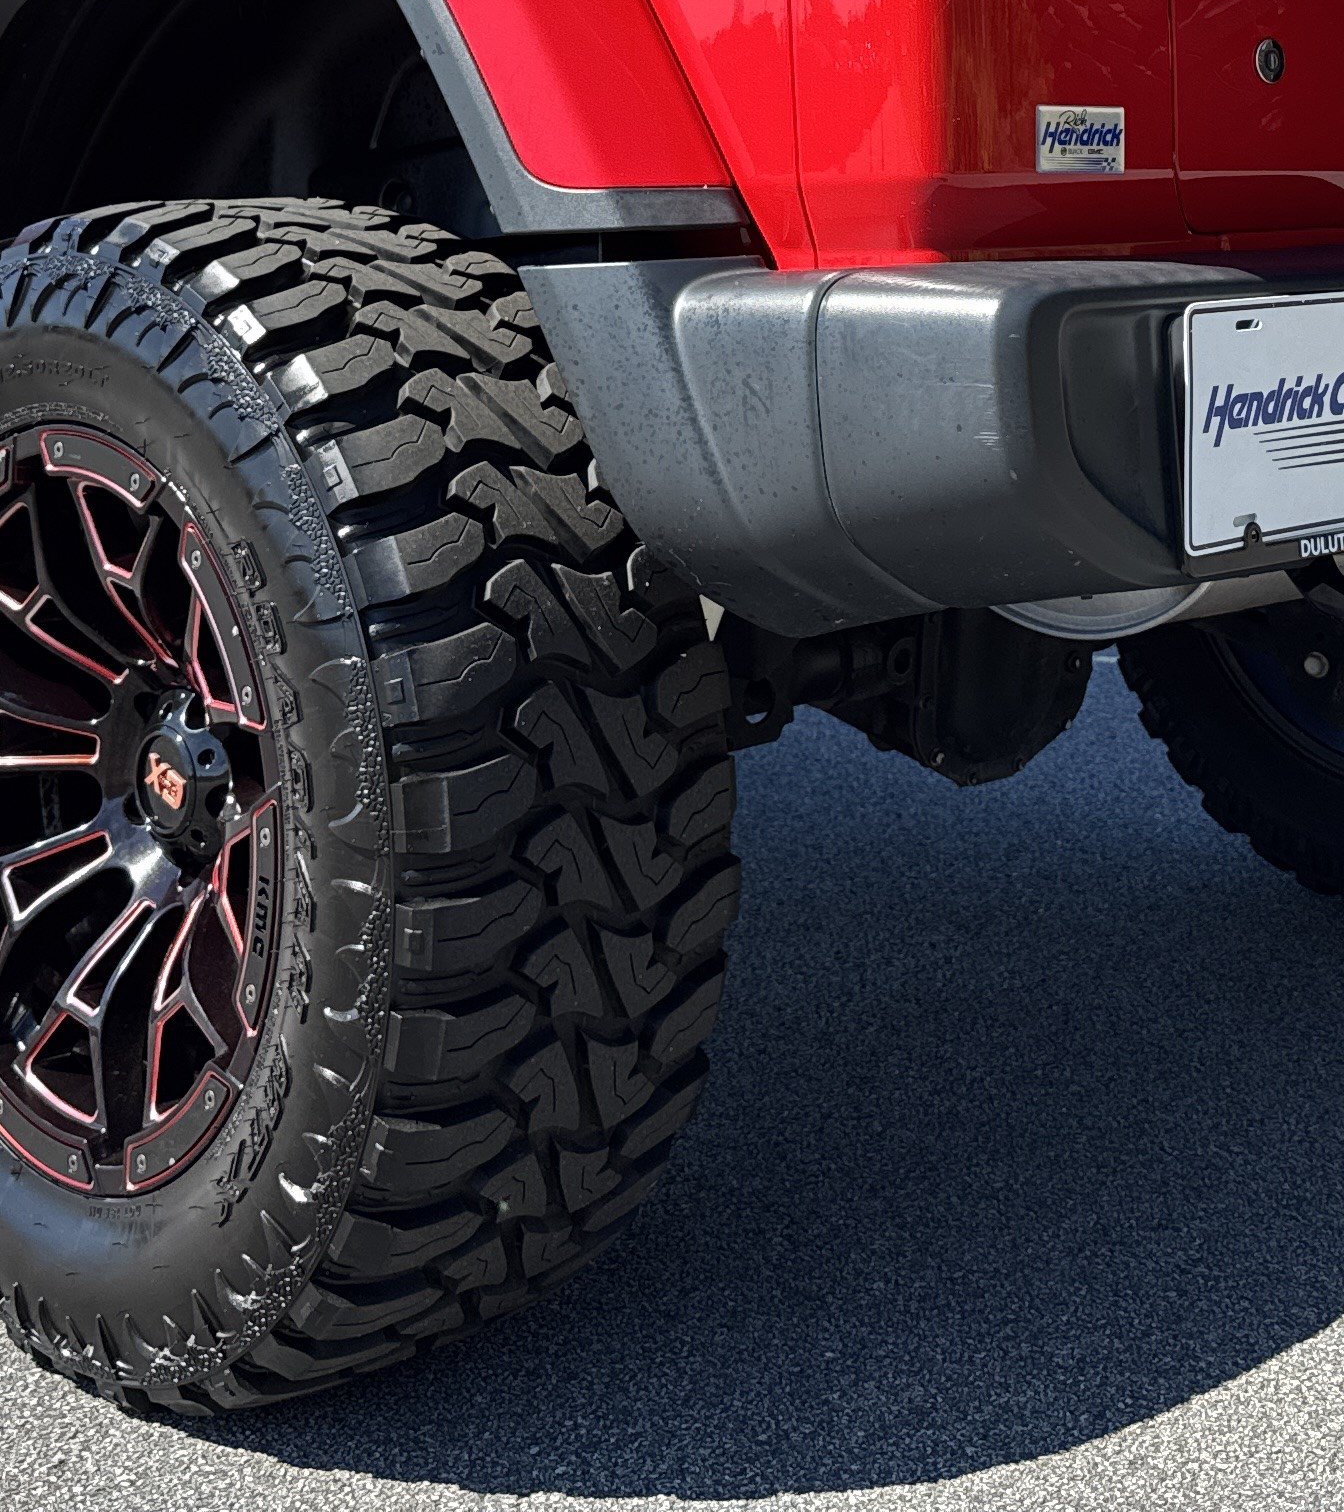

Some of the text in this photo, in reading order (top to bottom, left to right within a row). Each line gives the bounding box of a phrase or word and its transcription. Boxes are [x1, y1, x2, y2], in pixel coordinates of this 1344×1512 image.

[1059, 109, 1087, 129] Rick
[1041, 122, 1123, 153] Hendrick
[257, 874, 271, 959] KMC
